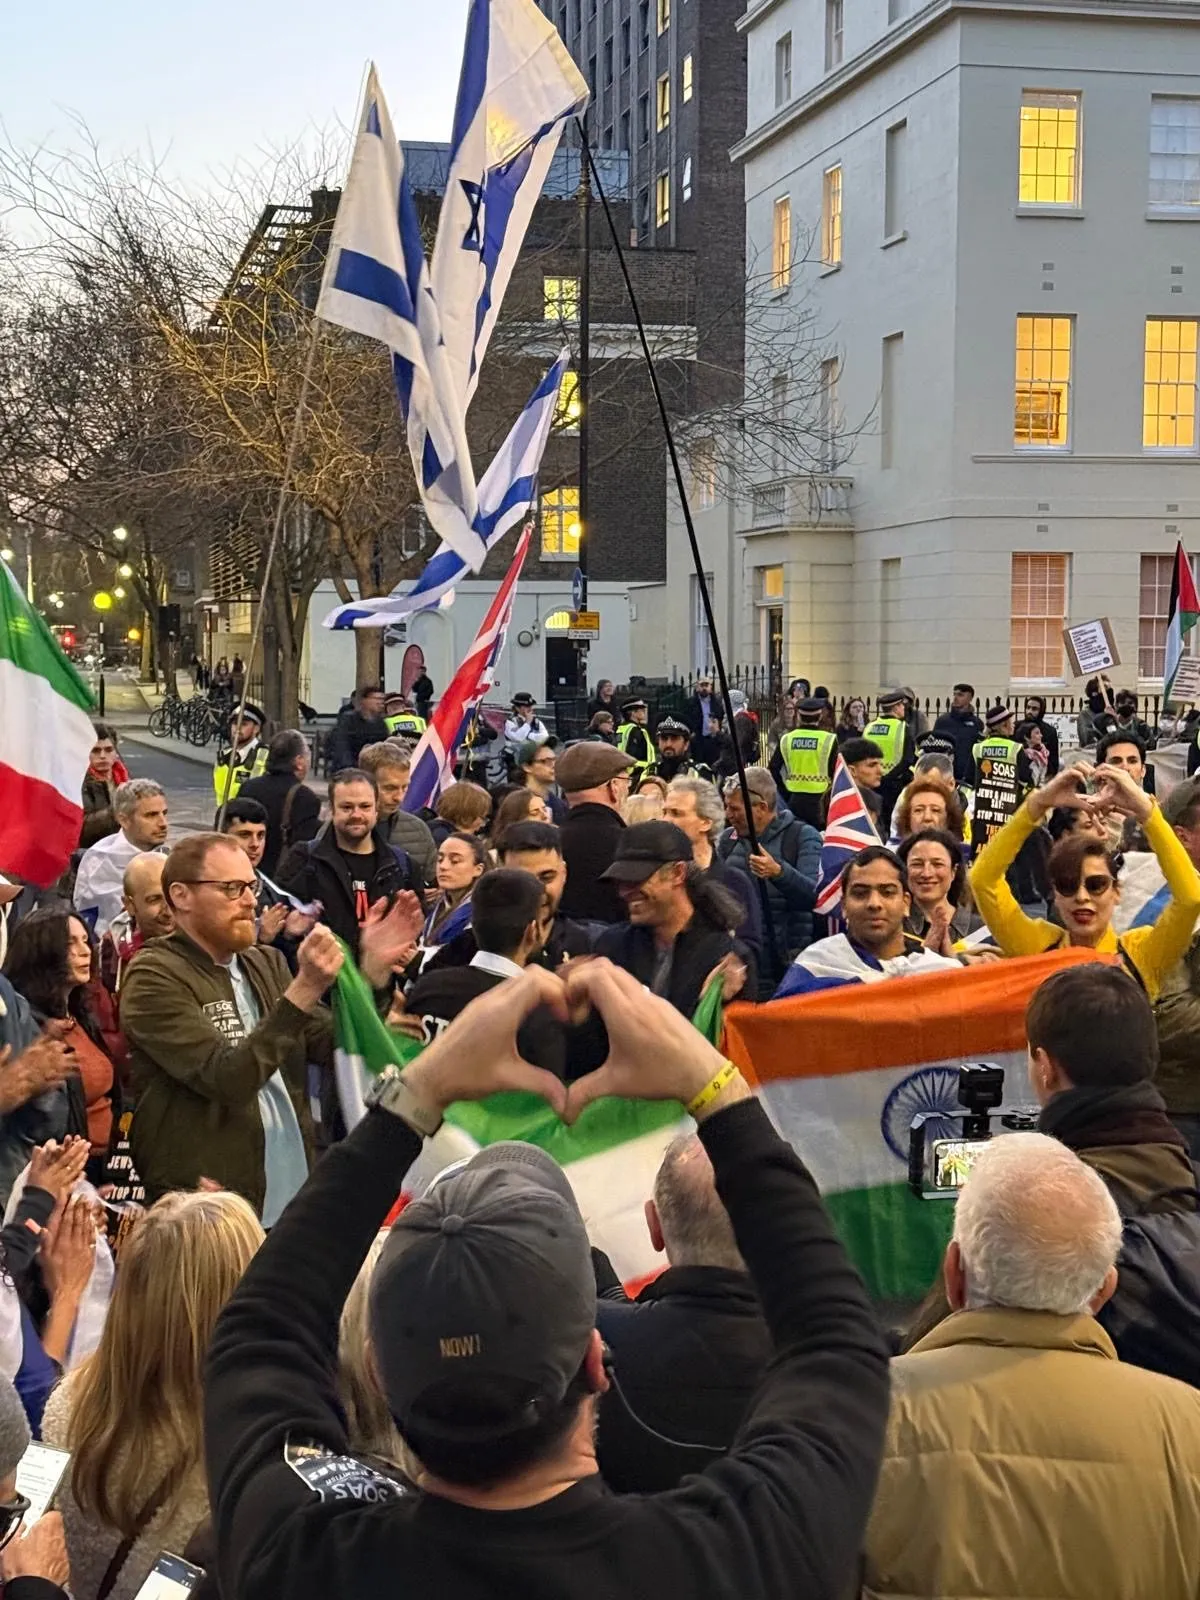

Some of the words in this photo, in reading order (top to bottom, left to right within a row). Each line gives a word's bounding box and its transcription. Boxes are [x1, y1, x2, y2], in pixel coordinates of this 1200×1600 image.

[793, 739, 816, 748] POLICE
[983, 748, 1006, 756] POLICE
[992, 762, 1015, 778] SOAS
[977, 788, 993, 799] JEWS
[977, 810, 993, 821] STOP
[994, 812, 1004, 822] THE
